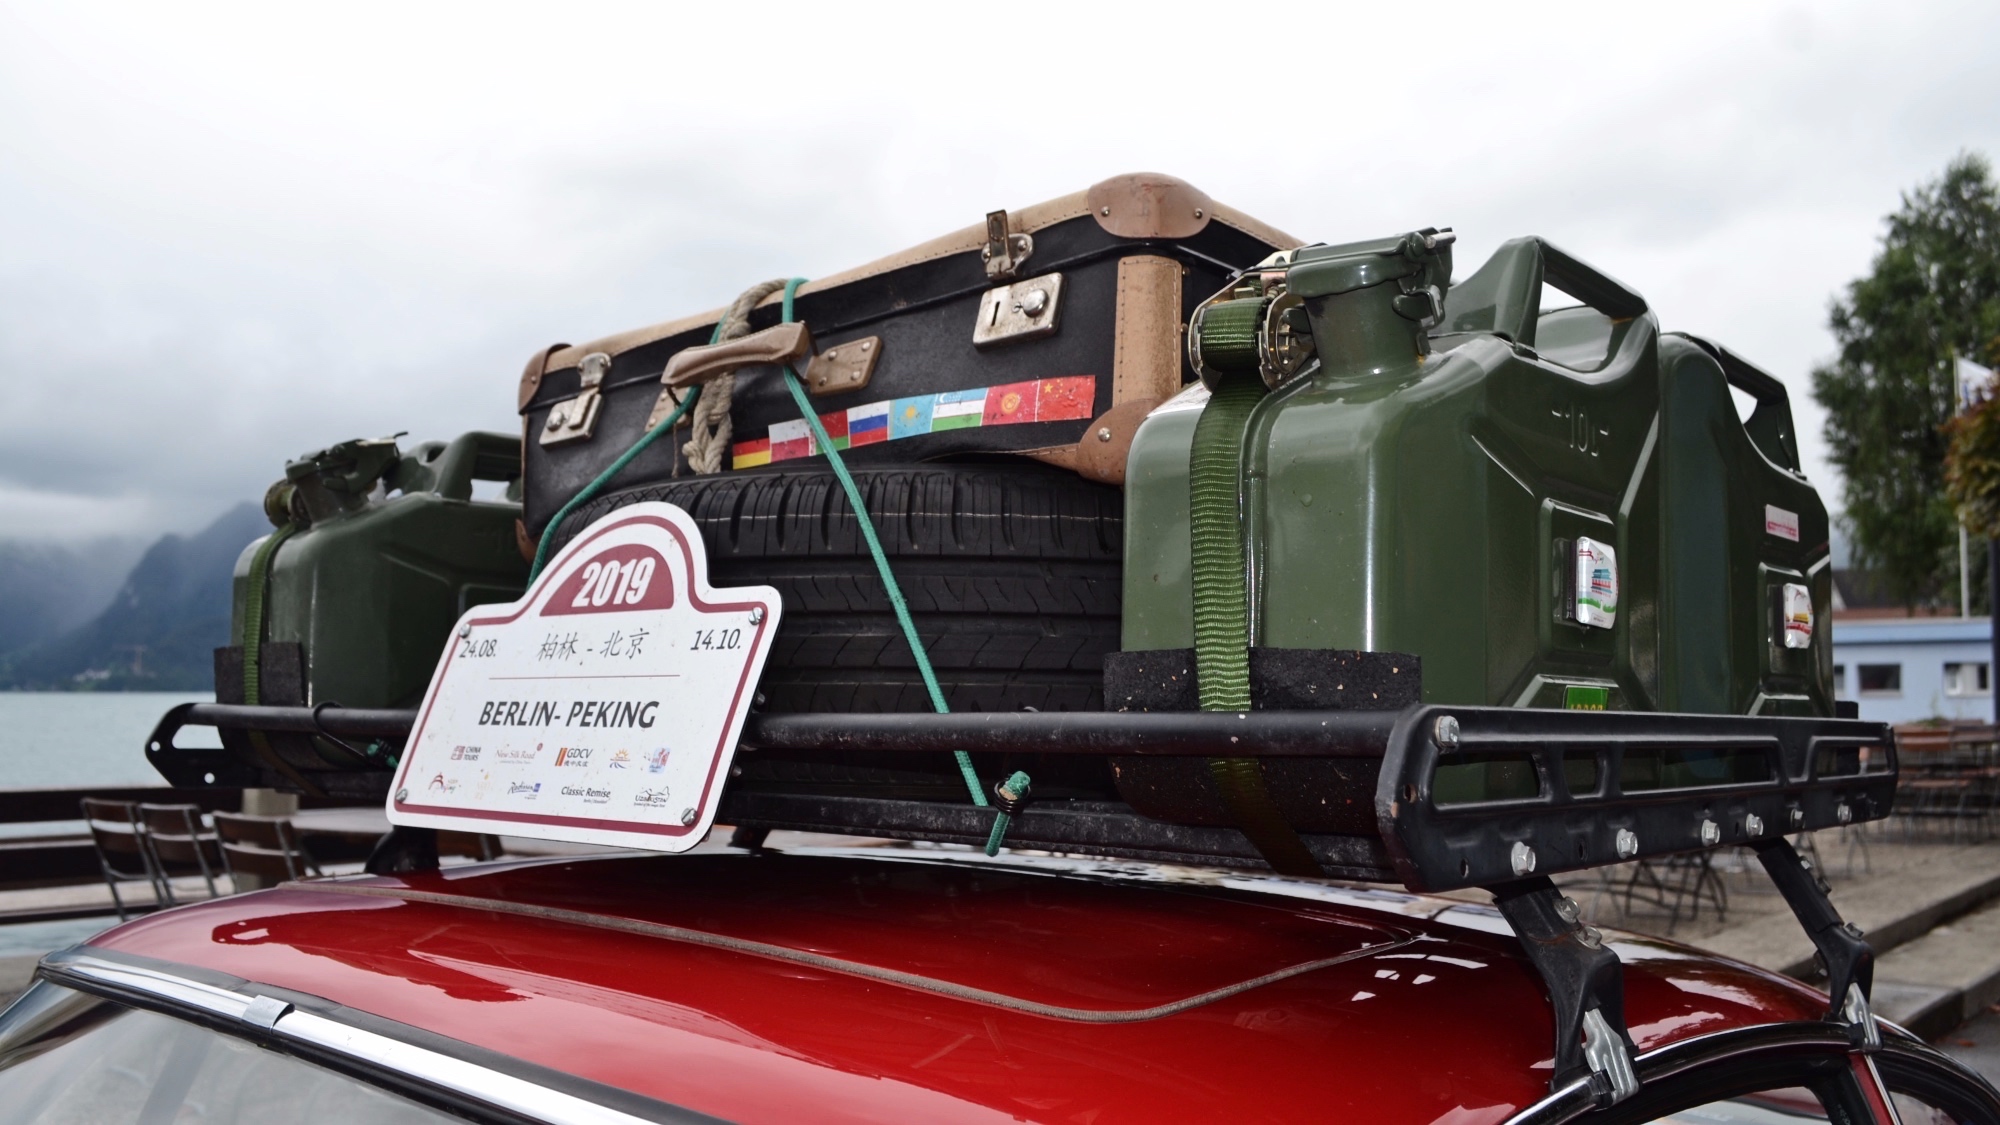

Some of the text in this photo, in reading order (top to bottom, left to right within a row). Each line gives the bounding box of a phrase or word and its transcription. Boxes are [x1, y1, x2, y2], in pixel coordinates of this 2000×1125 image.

[571, 557, 656, 607] 2019
[459, 639, 497, 658] 24.08.
[537, 631, 579, 661] 柏林
[600, 627, 650, 660] 北京
[690, 628, 742, 651] 14.10.
[566, 701, 660, 729] PEKING
[465, 746, 481, 754] CHINA
[566, 748, 593, 758] GDCV
[561, 786, 611, 798] Classic Remise
